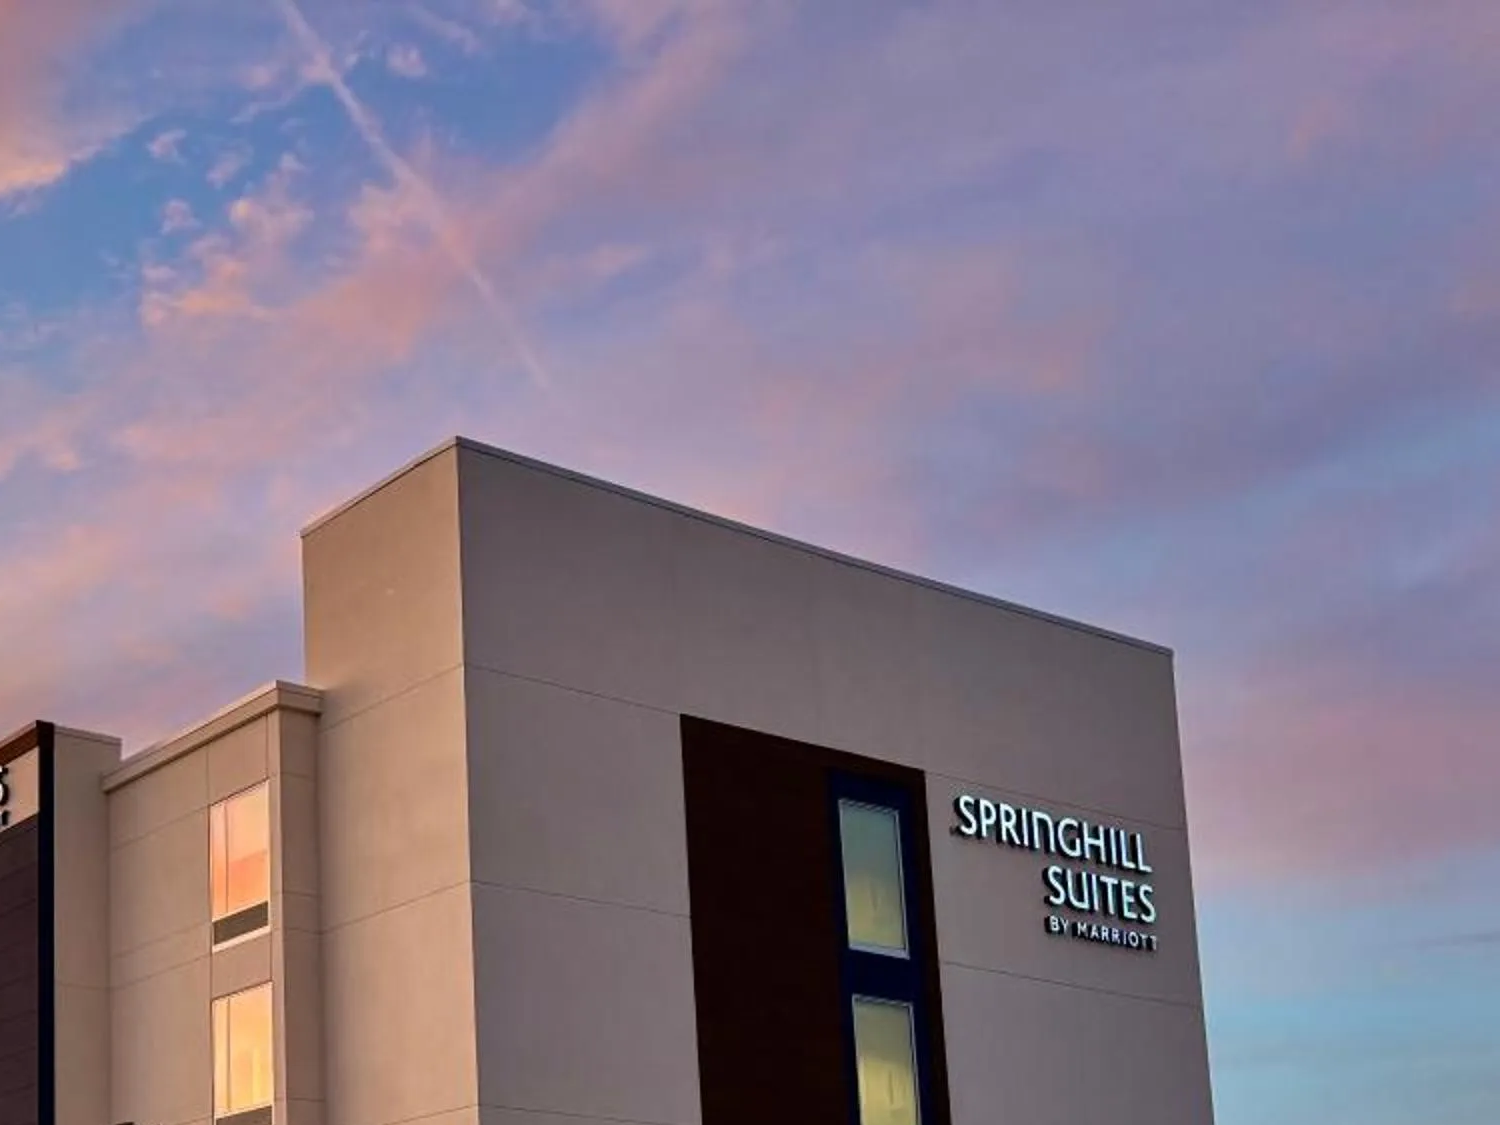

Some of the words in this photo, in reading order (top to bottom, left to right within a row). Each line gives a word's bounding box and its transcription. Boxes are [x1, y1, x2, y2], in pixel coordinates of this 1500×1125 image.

[957, 795, 1153, 873] SPRINGHILL
[1047, 865, 1157, 924] SUITES
[1049, 915, 1069, 932] BY
[1077, 922, 1157, 951] MARRIOTT
